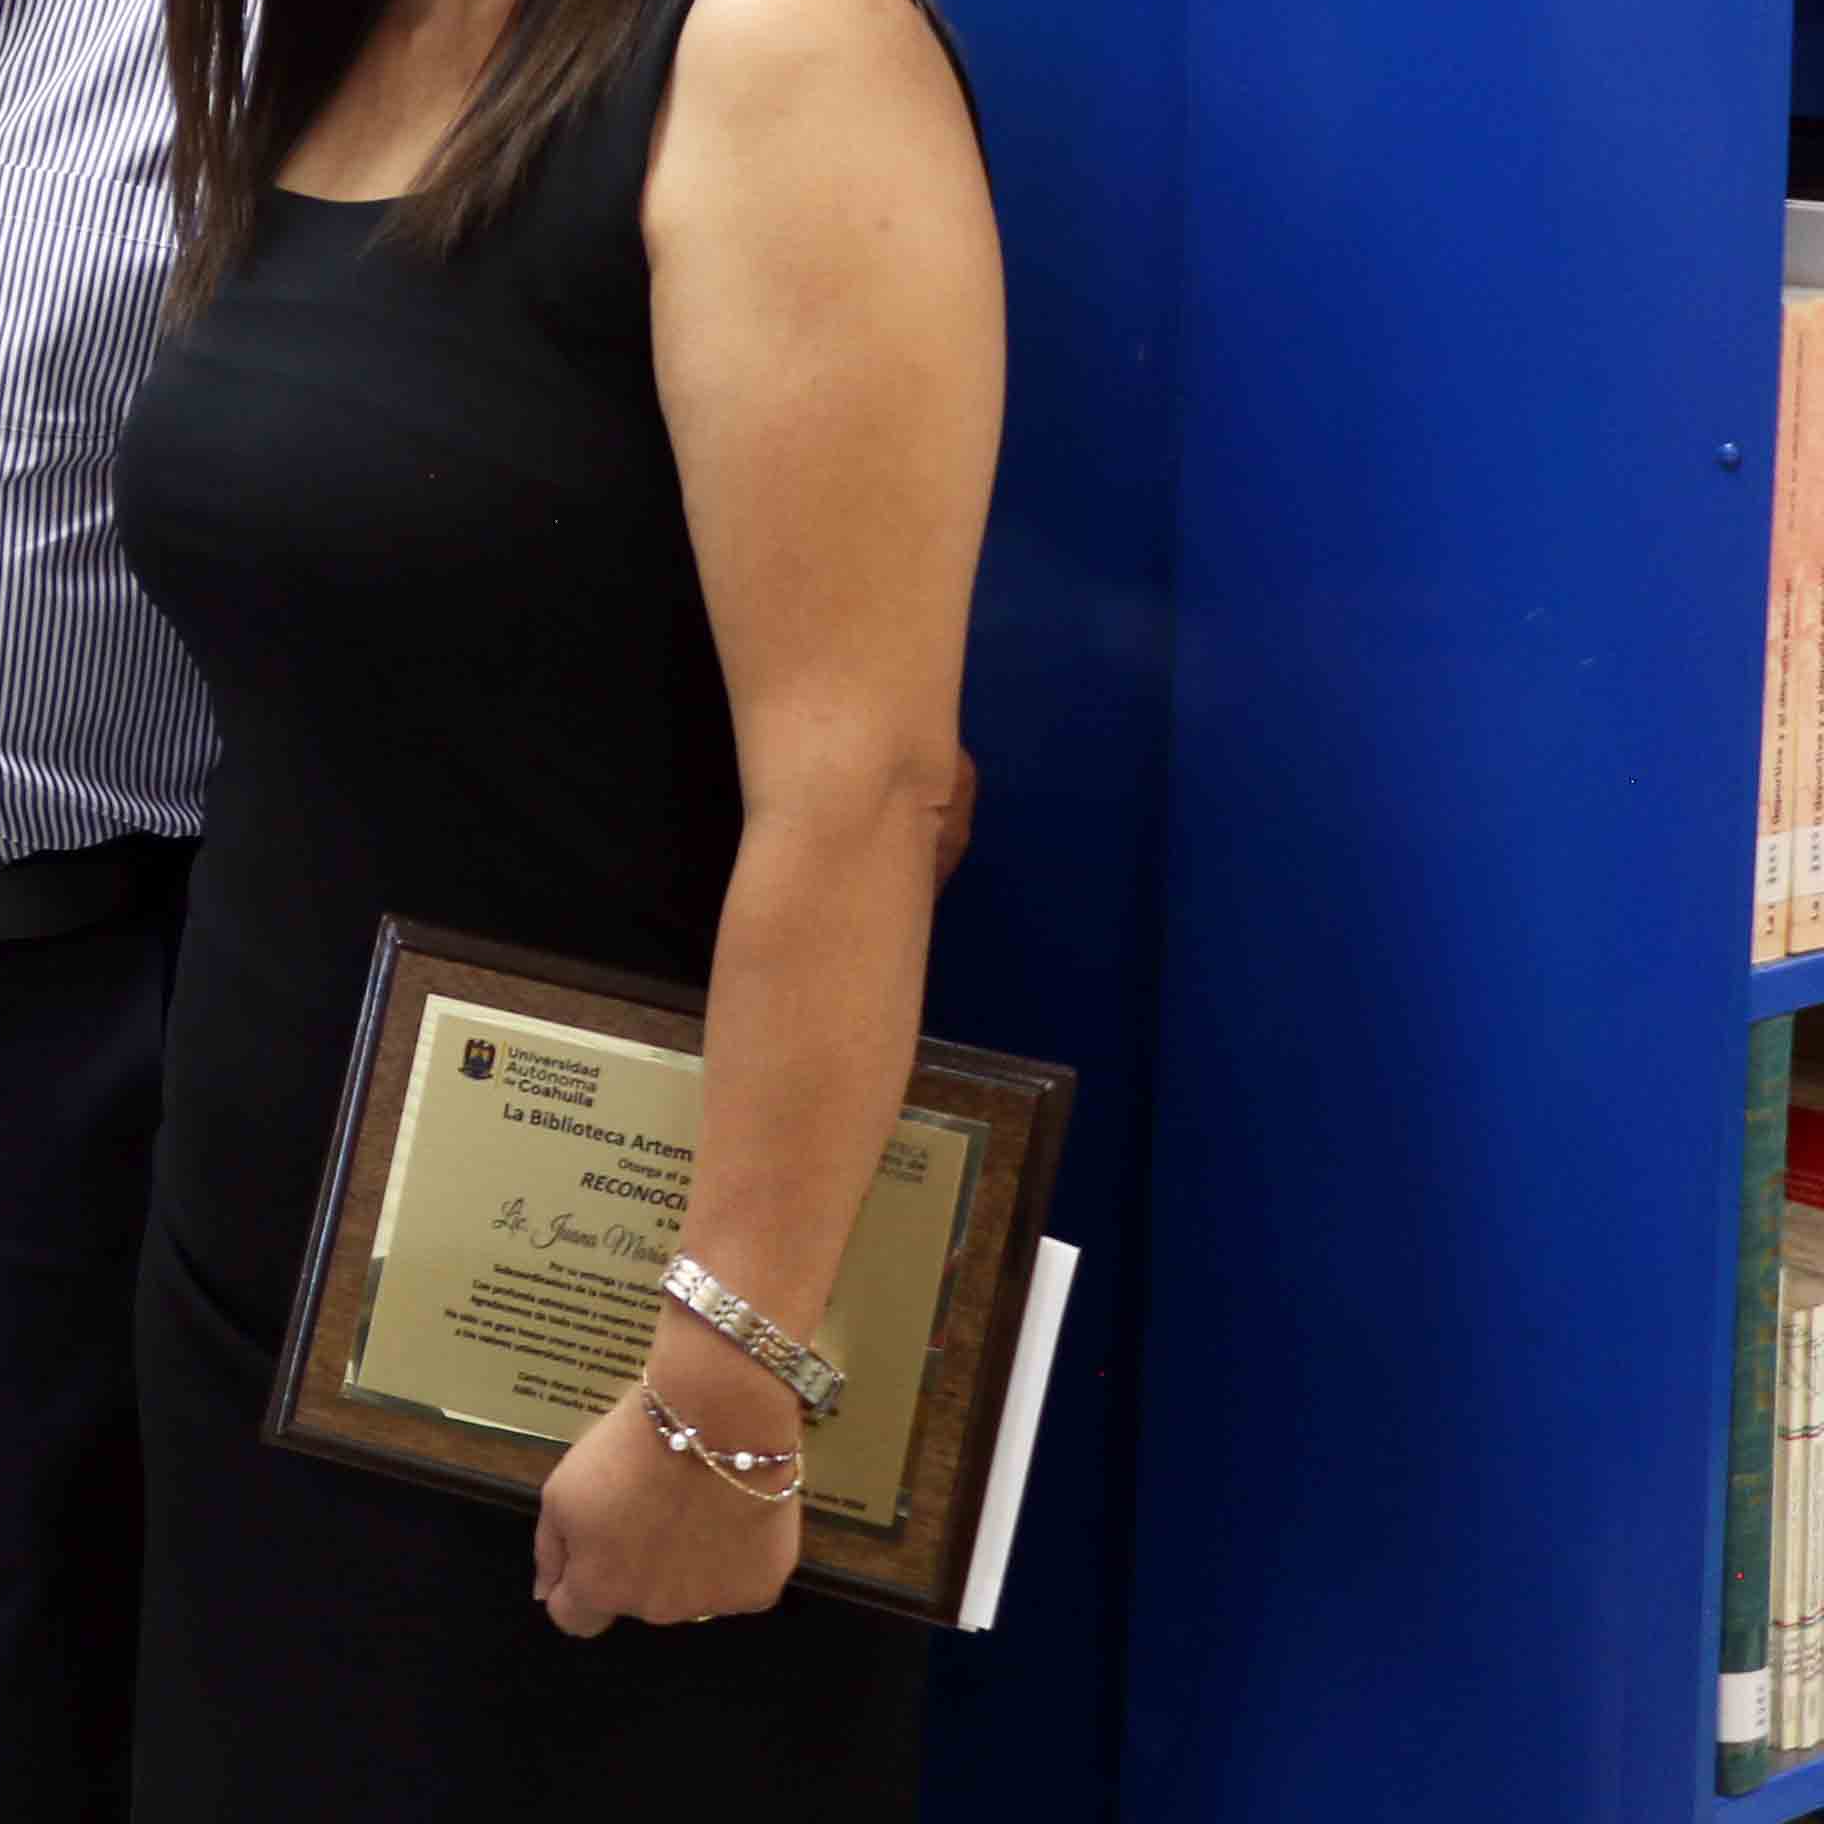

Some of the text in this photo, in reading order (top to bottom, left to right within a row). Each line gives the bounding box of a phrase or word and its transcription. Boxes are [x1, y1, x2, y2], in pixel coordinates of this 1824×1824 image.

[504, 1061, 598, 1093] Autónoma
[507, 1045, 601, 1078] Universidad
[518, 1078, 595, 1107] Coahuila
[503, 1103, 694, 1163] La Biblioteca Artem
[579, 1171, 689, 1211] RECONOCI
